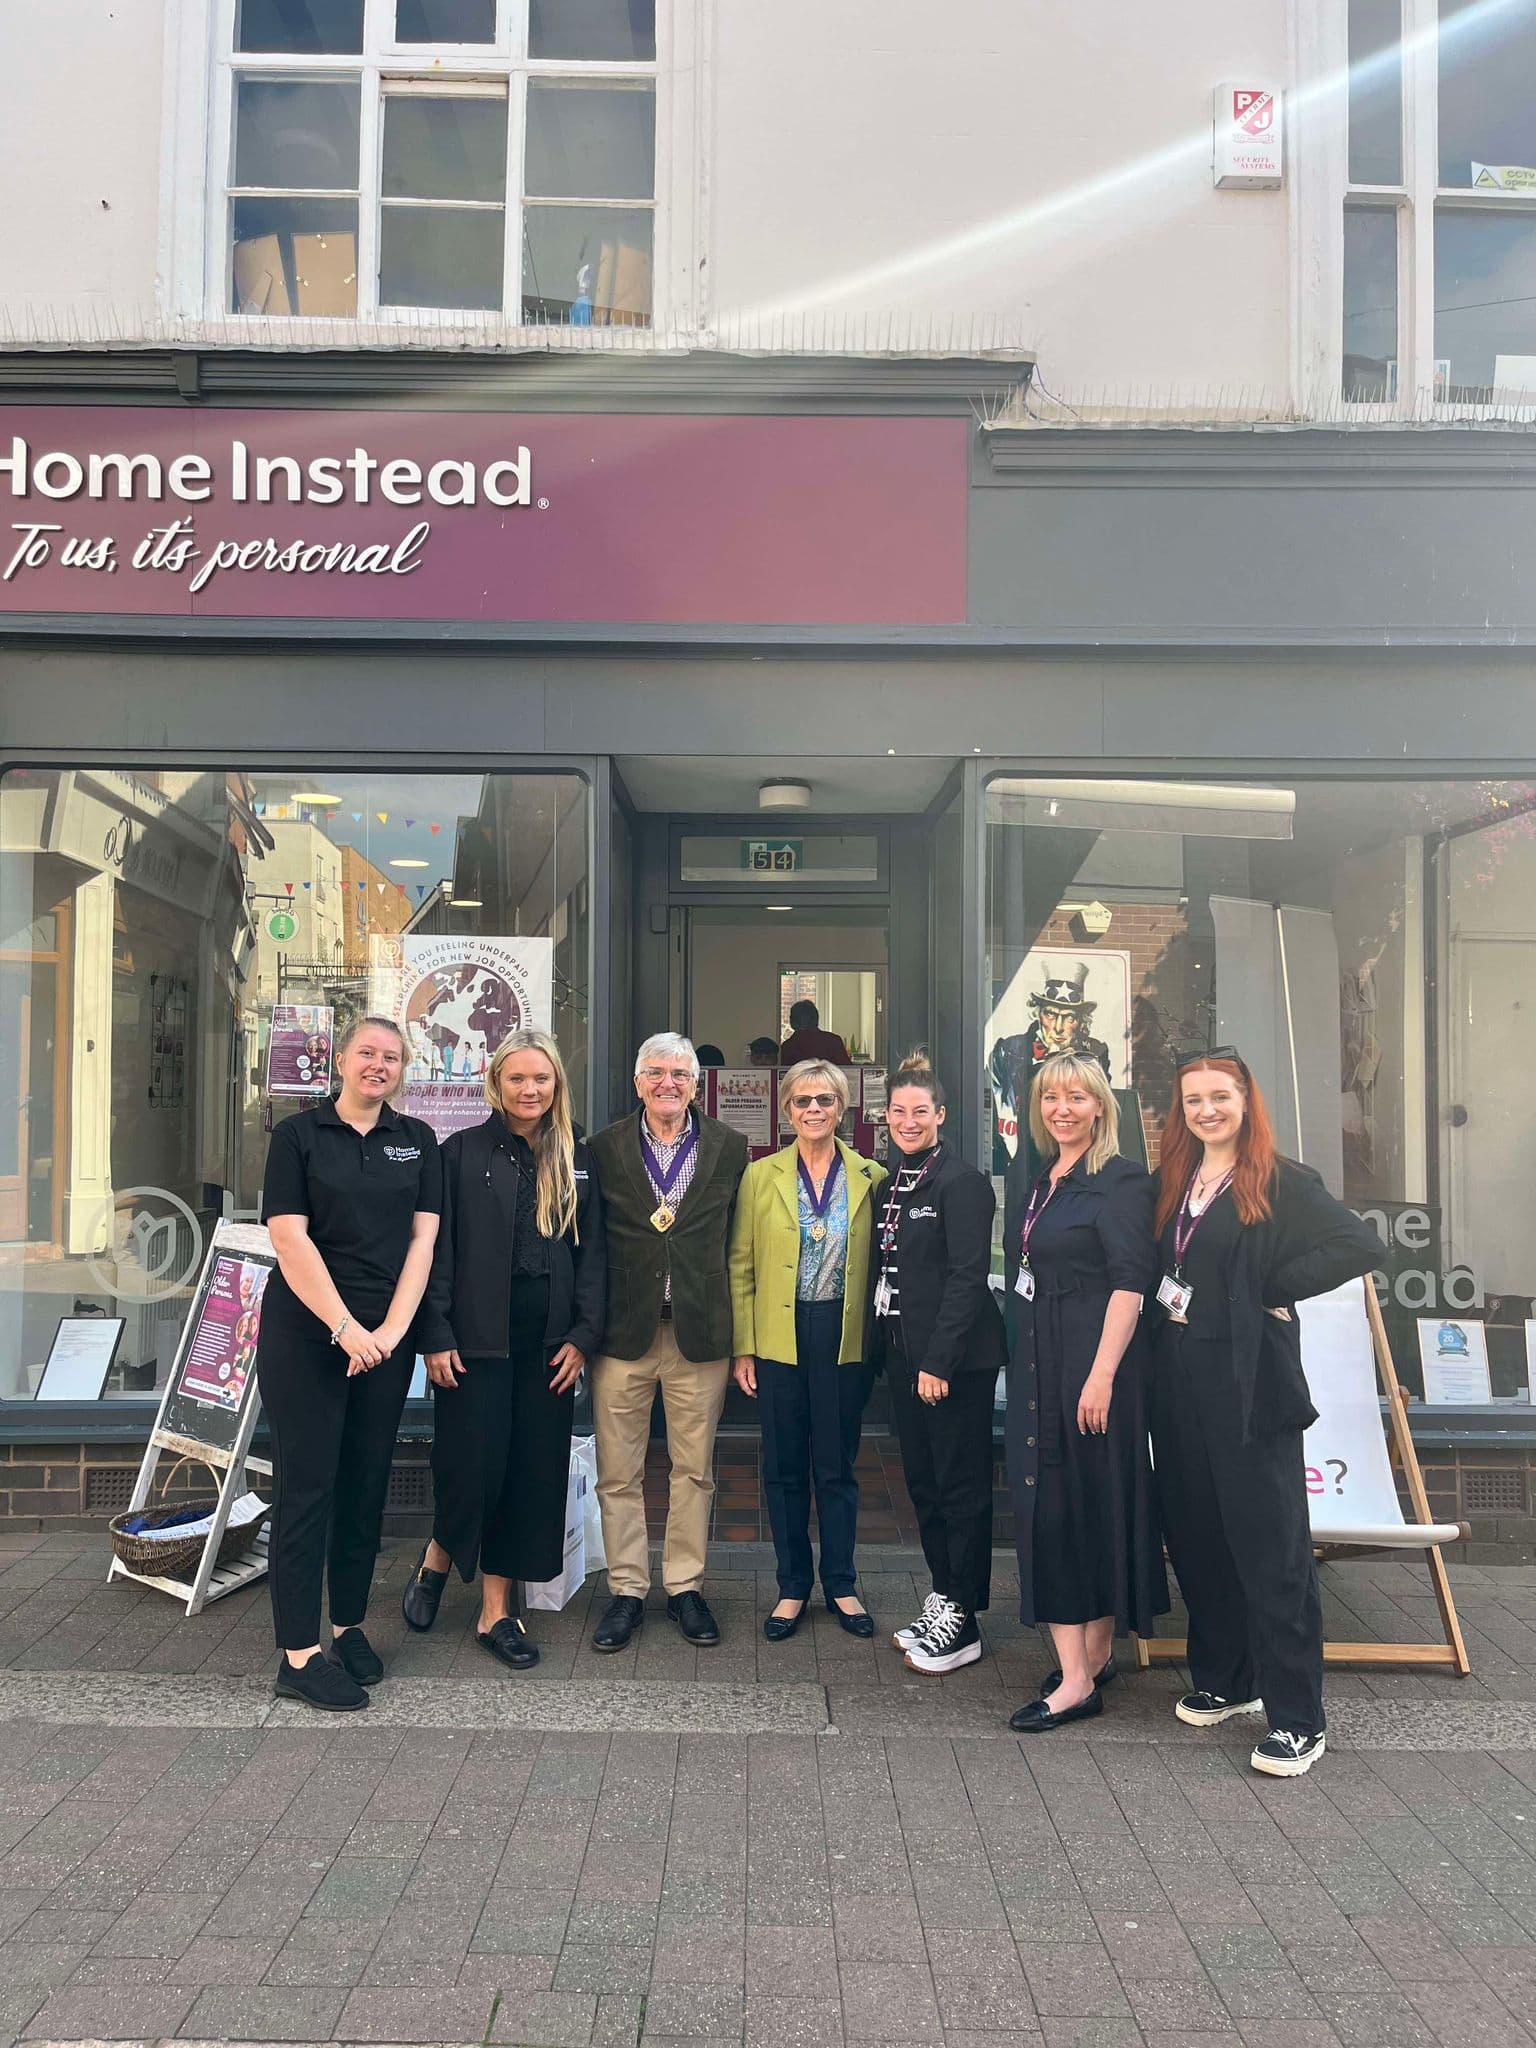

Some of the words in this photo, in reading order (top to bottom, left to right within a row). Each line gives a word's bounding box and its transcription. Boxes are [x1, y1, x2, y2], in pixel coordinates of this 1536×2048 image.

[1238, 93, 1252, 109] P
[1254, 112, 1269, 128] J
[0, 437, 211, 501] Home
[3, 524, 62, 580] To
[61, 537, 117, 572] us,
[132, 515, 201, 571] it's
[189, 522, 430, 592] personal
[398, 964, 412, 982] ARE
[411, 949, 432, 965] YOU
[435, 941, 475, 953] FEELING
[479, 943, 529, 978] UNDERPAID
[393, 967, 425, 1017] SEARCHING
[427, 956, 447, 969] FOR
[450, 953, 472, 961] NEW
[476, 955, 495, 968] JOB
[441, 1085, 464, 1097] who
